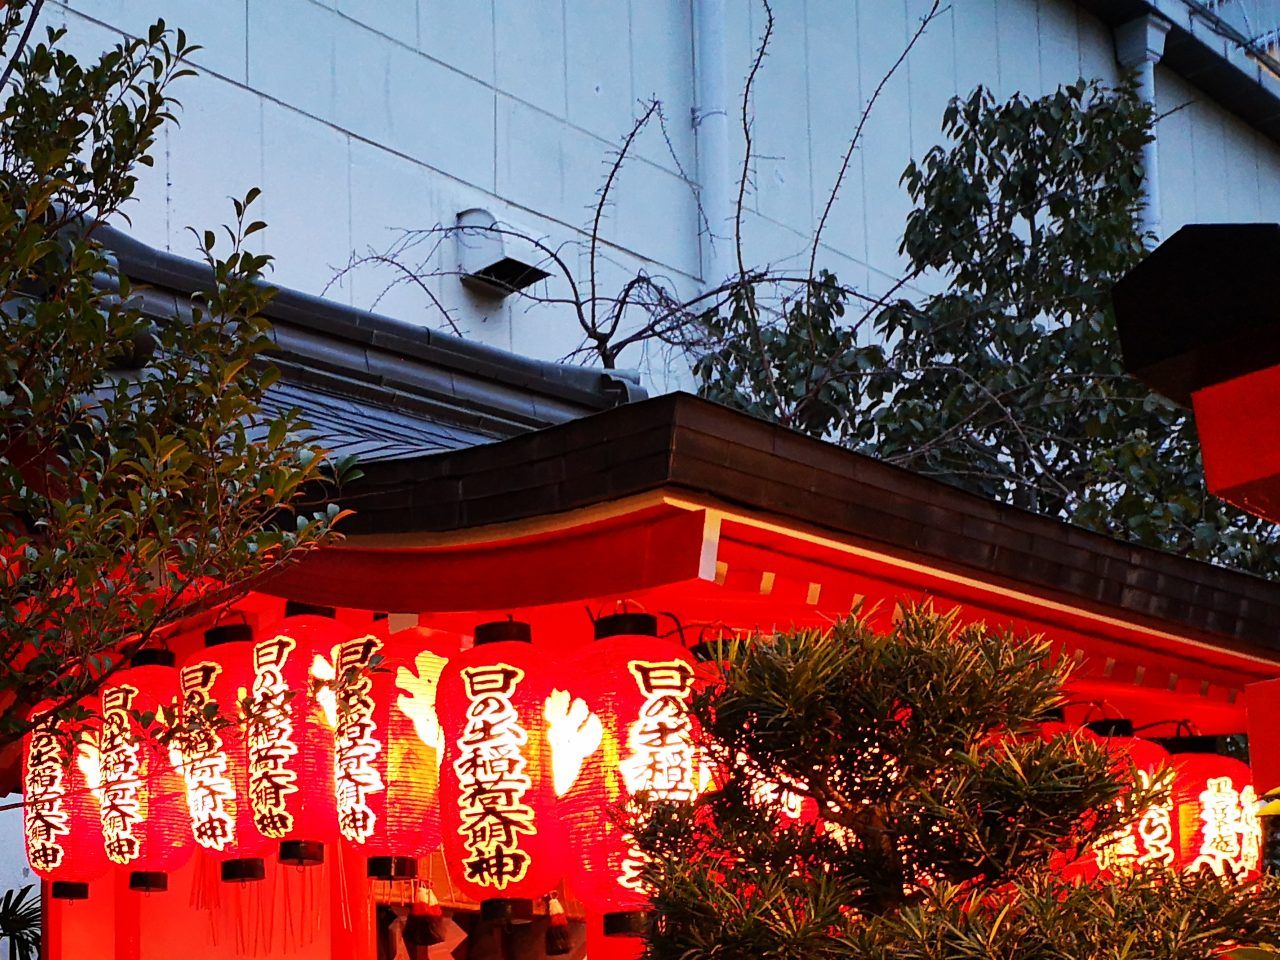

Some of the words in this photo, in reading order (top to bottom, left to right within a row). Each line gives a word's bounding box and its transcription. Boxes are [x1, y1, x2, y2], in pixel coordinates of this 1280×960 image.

[456, 664, 532, 888] 日の出稲荷大明神
